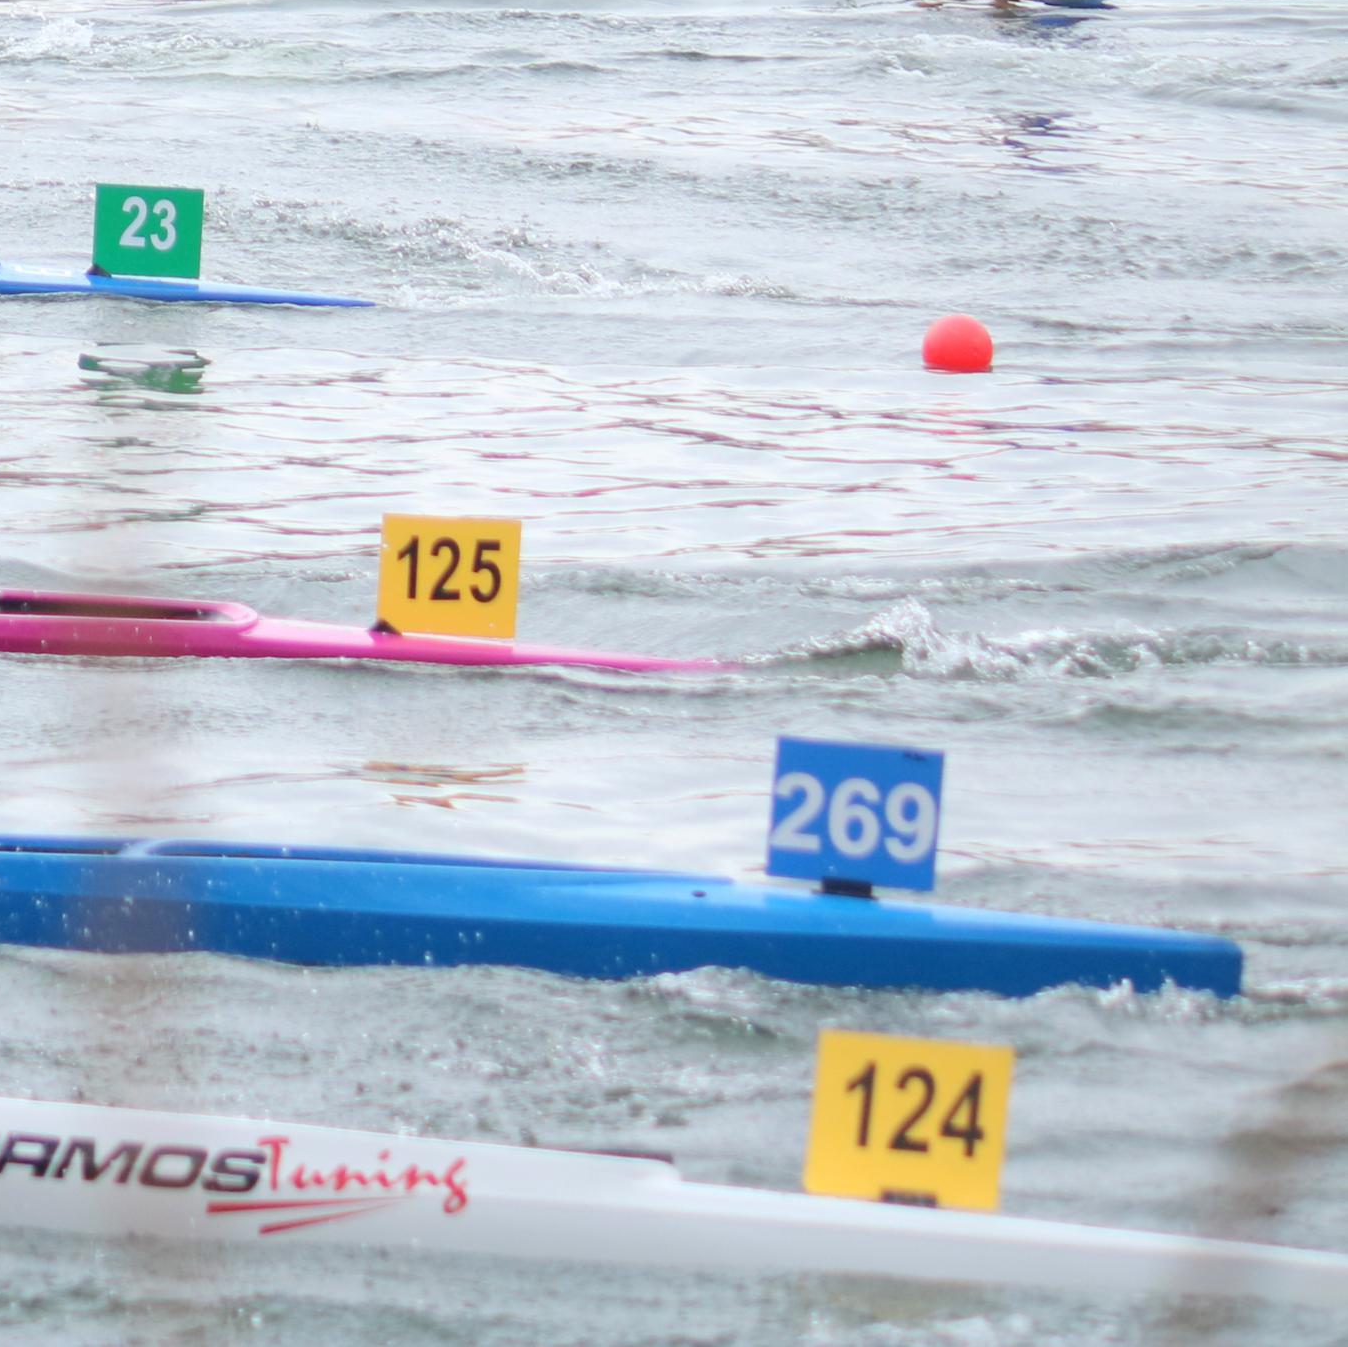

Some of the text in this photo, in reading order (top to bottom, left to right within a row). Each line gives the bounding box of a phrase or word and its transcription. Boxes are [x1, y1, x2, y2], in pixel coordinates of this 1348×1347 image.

[118, 195, 177, 252] 23
[396, 536, 503, 604] 125
[769, 770, 938, 865] 269
[844, 1060, 986, 1160] 124
[257, 1135, 471, 1216] Tuning
